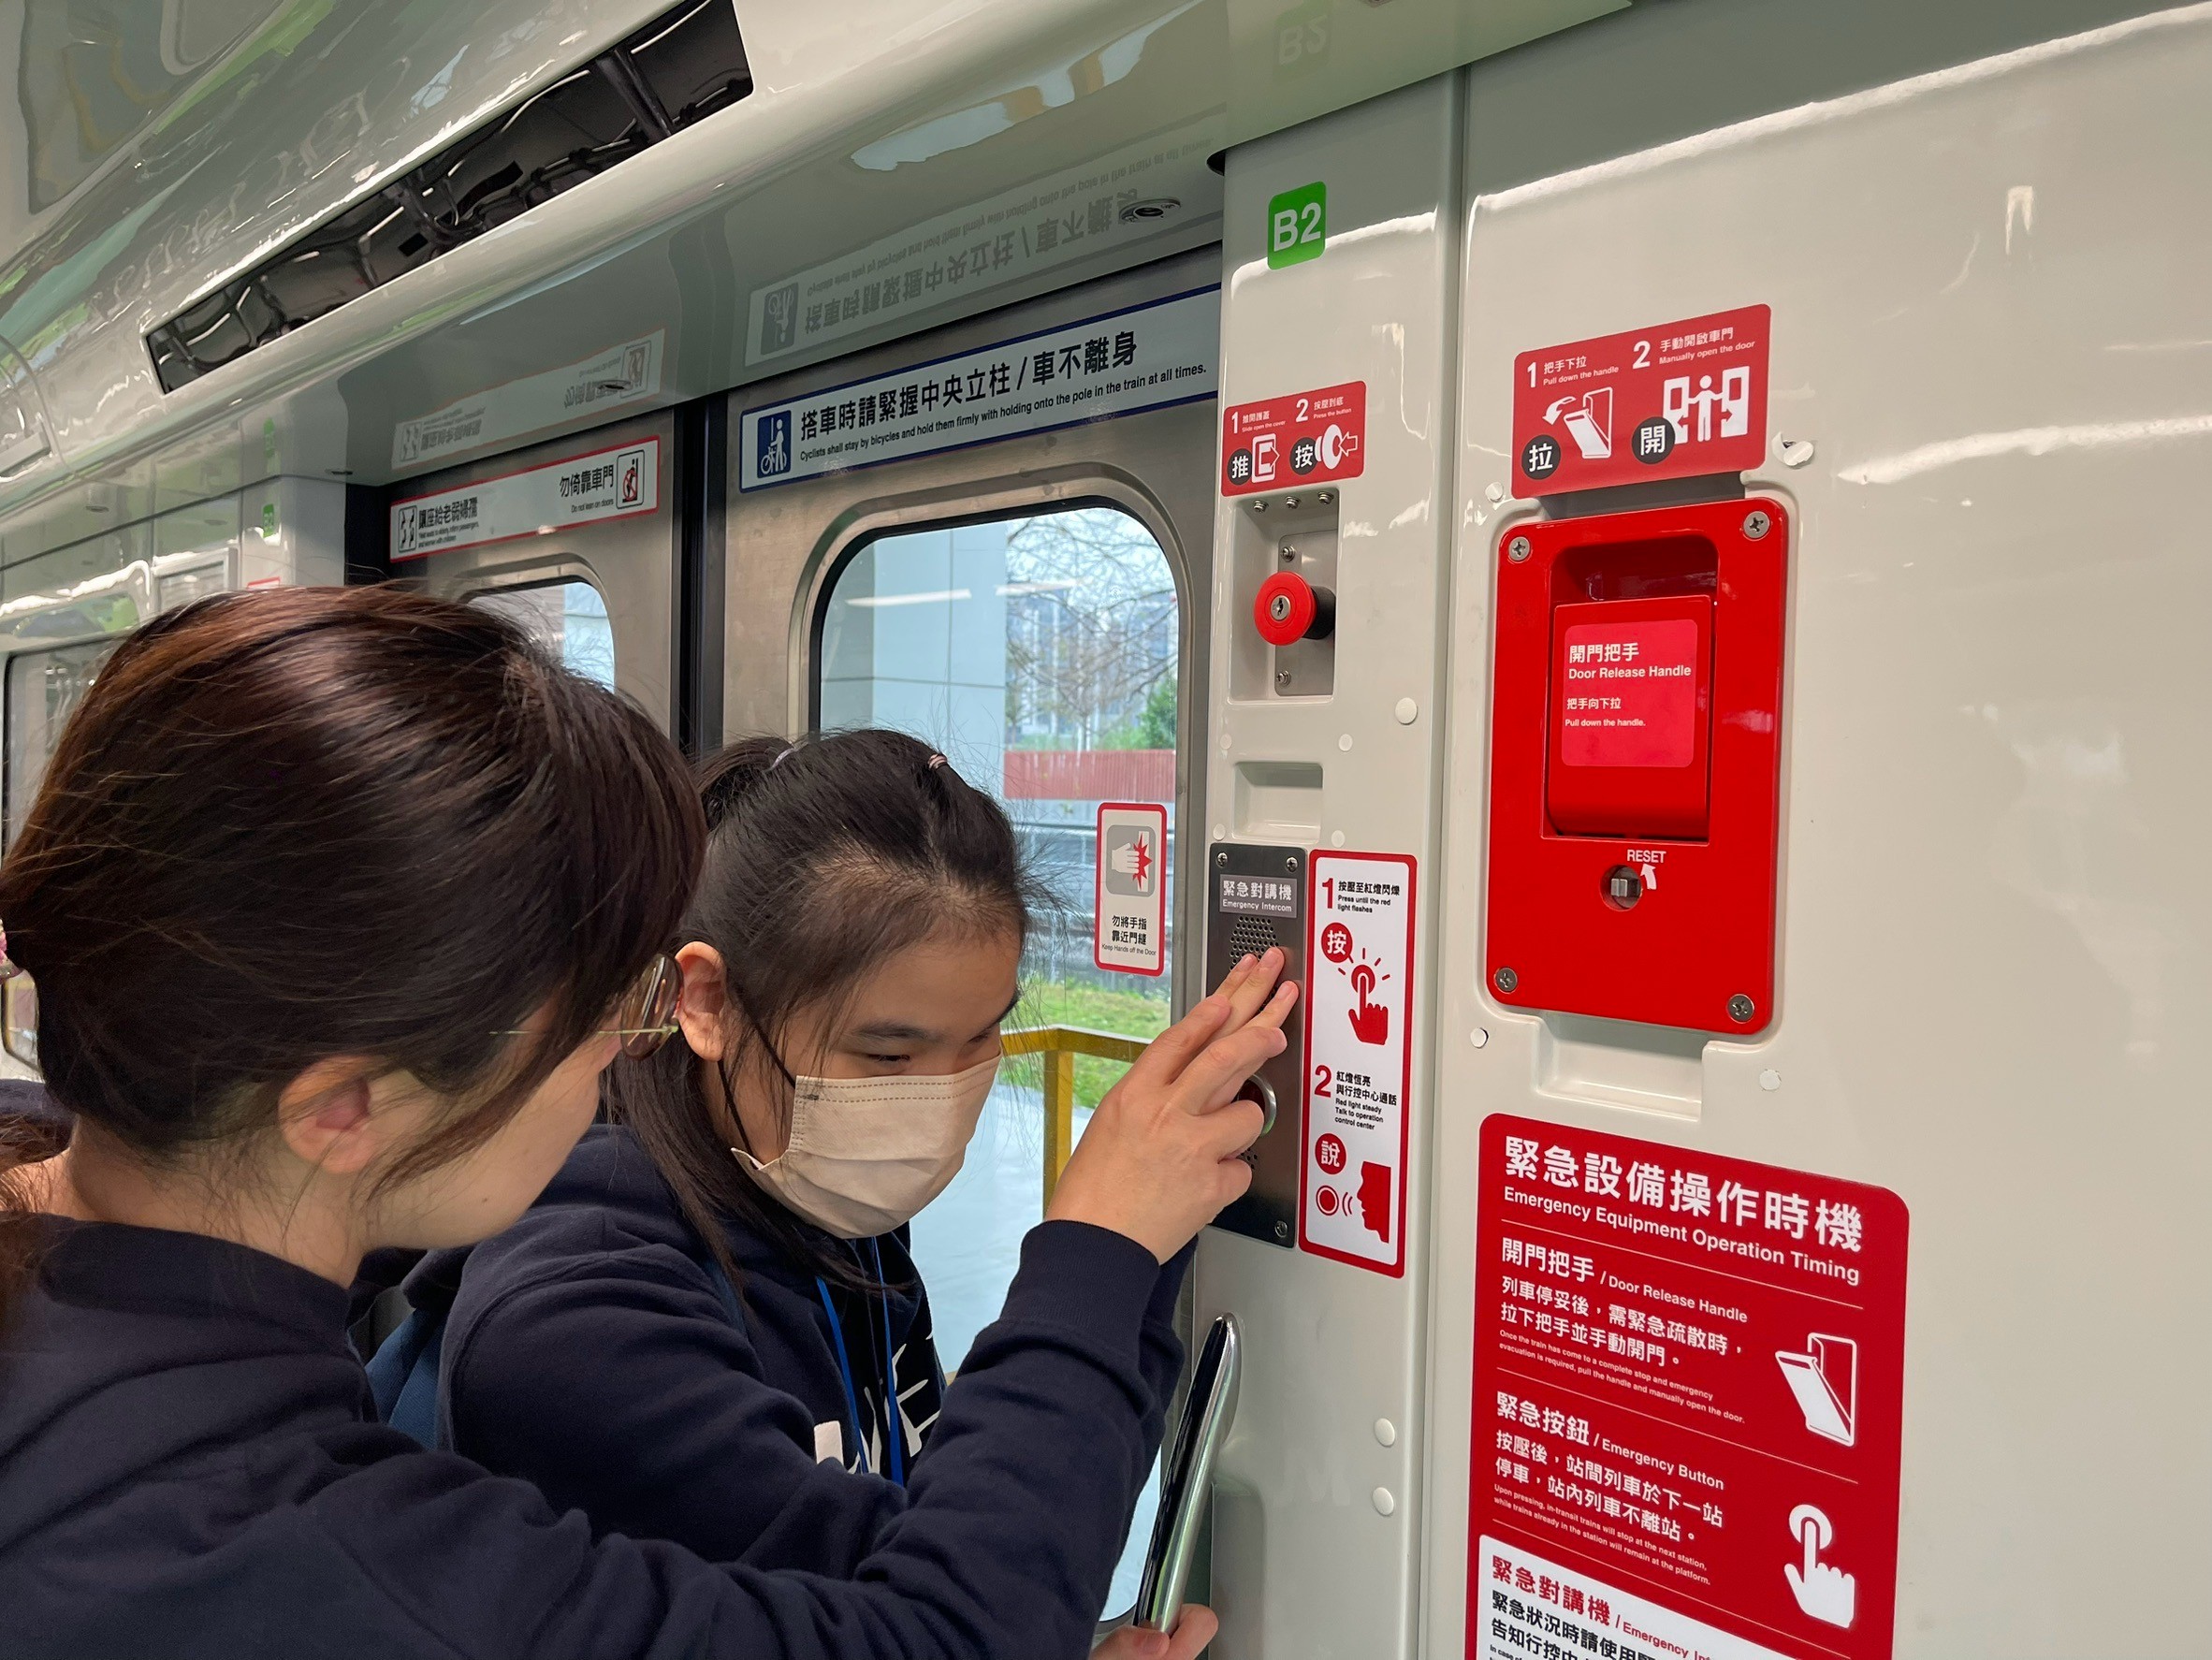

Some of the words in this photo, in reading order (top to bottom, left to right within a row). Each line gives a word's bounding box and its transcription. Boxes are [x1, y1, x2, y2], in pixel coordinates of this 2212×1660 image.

[1273, 202, 1321, 252] B2
[1633, 341, 1651, 369] 2
[1659, 352, 1695, 364] Manually
[1697, 348, 1717, 357] open
[1736, 342, 1755, 351] door
[1527, 362, 1535, 387] 1
[1544, 356, 1587, 374] 把手下拉
[1543, 377, 1556, 386] Pull
[1558, 374, 1578, 383] down
[1594, 366, 1619, 376] handle
[800, 446, 825, 461] Cyclists
[827, 443, 843, 455] shall
[844, 441, 858, 452] stay
[861, 437, 868, 448] by
[871, 432, 900, 444] bicycles
[902, 428, 915, 438] and
[917, 421, 933, 435] hold
[936, 418, 954, 431] them
[956, 414, 979, 429] firmly
[982, 409, 997, 421] with
[1000, 402, 1031, 417] holding
[1034, 398, 1053, 410] onto
[1056, 393, 1070, 405] the
[1072, 388, 1092, 404] pole
[1095, 386, 1103, 397] in
[1106, 382, 1121, 395] the
[1124, 377, 1145, 390] train
[1149, 374, 1157, 385] at
[1160, 369, 1171, 382] all
[1175, 363, 1206, 379] times.
[1231, 412, 1238, 433] 1
[1296, 399, 1308, 422] 2
[1640, 425, 1666, 456] 開
[1232, 455, 1248, 478] 推
[1295, 444, 1313, 468] 按
[1529, 443, 1553, 472] 拉
[560, 464, 614, 497] 勿倚靠車門
[1569, 643, 1639, 663] 開門把手
[1568, 669, 1596, 678] Door
[1600, 667, 1645, 678] Release
[1649, 665, 1691, 677] Handle
[1567, 697, 1621, 709] 把手向下拉
[1627, 850, 1666, 863] RESET
[1224, 881, 1291, 900] 緊急對講機
[1322, 878, 1333, 909] 1
[1223, 899, 1259, 910] Emergency
[1262, 902, 1291, 911] Intercom
[1113, 915, 1146, 930] 勿將手指
[1113, 930, 1146, 945] 靠近門縫
[1328, 930, 1346, 955] 按
[1315, 1065, 1332, 1098] 2
[1337, 1070, 1370, 1086] 紅燈恆亮
[1335, 1098, 1346, 1106] Red
[1348, 1100, 1361, 1109] light
[1362, 1103, 1381, 1114] steady
[1336, 1084, 1397, 1106] 與行控中心通話
[1335, 1116, 1355, 1126] control
[1357, 1120, 1375, 1129] center
[1356, 1112, 1383, 1122] operation
[1321, 1141, 1341, 1167] 說
[1506, 1135, 1862, 1253] 緊急設備操作時機
[1505, 1186, 1591, 1221] Emergency
[1596, 1206, 1687, 1242] Equipment
[1693, 1229, 1784, 1264] Operation
[1791, 1250, 1859, 1287] Timing
[1502, 1237, 1594, 1283] 開門把手
[1608, 1275, 1639, 1294] Door
[1643, 1285, 1695, 1308] Release
[1699, 1299, 1748, 1323] Handle
[1500, 1330, 1517, 1340] Once
[1519, 1334, 1529, 1344] the
[1531, 1338, 1546, 1349] train
[1549, 1343, 1561, 1353] has
[1563, 1348, 1581, 1360] come
[1598, 1360, 1633, 1376] complete
[1635, 1370, 1651, 1381] stop
[1652, 1376, 1667, 1386] and
[1669, 1381, 1713, 1401] emergency
[1499, 1343, 1535, 1359] evacuation
[1545, 1356, 1576, 1372] required,
[1578, 1367, 1591, 1376] pull
[1593, 1371, 1605, 1380] the
[1607, 1374, 1632, 1389] handle
[1633, 1383, 1648, 1393] and
[1649, 1388, 1684, 1405] manually
[1686, 1400, 1706, 1410] open
[1709, 1405, 1721, 1416] the
[1724, 1410, 1745, 1423] door.
[1497, 1391, 1589, 1446] 緊急按鈕
[1602, 1438, 1674, 1475] Emergency
[1679, 1464, 1724, 1490] Button
[1494, 1483, 1512, 1496] Upon
[1514, 1493, 1545, 1509] pressing,
[1547, 1504, 1578, 1522] in-transit
[1580, 1517, 1601, 1530] trains
[1603, 1525, 1615, 1535] will
[1617, 1531, 1634, 1543] stop
[1636, 1537, 1642, 1546] at
[1645, 1540, 1656, 1551] the
[1659, 1547, 1675, 1558] next
[1678, 1553, 1707, 1571] station,
[1494, 1497, 1511, 1508] while
[1513, 1503, 1532, 1517] trains
[1534, 1512, 1559, 1528] already
[1562, 1522, 1567, 1531] in
[1569, 1525, 1580, 1536] the
[1583, 1531, 1608, 1546] station
[1610, 1541, 1622, 1551] will
[1624, 1547, 1650, 1563] remain
[1661, 1561, 1673, 1571] the
[1676, 1567, 1710, 1585] platform.
[1492, 1554, 1610, 1626] 緊急對講機
[1623, 1622, 1688, 1658] Emergency
